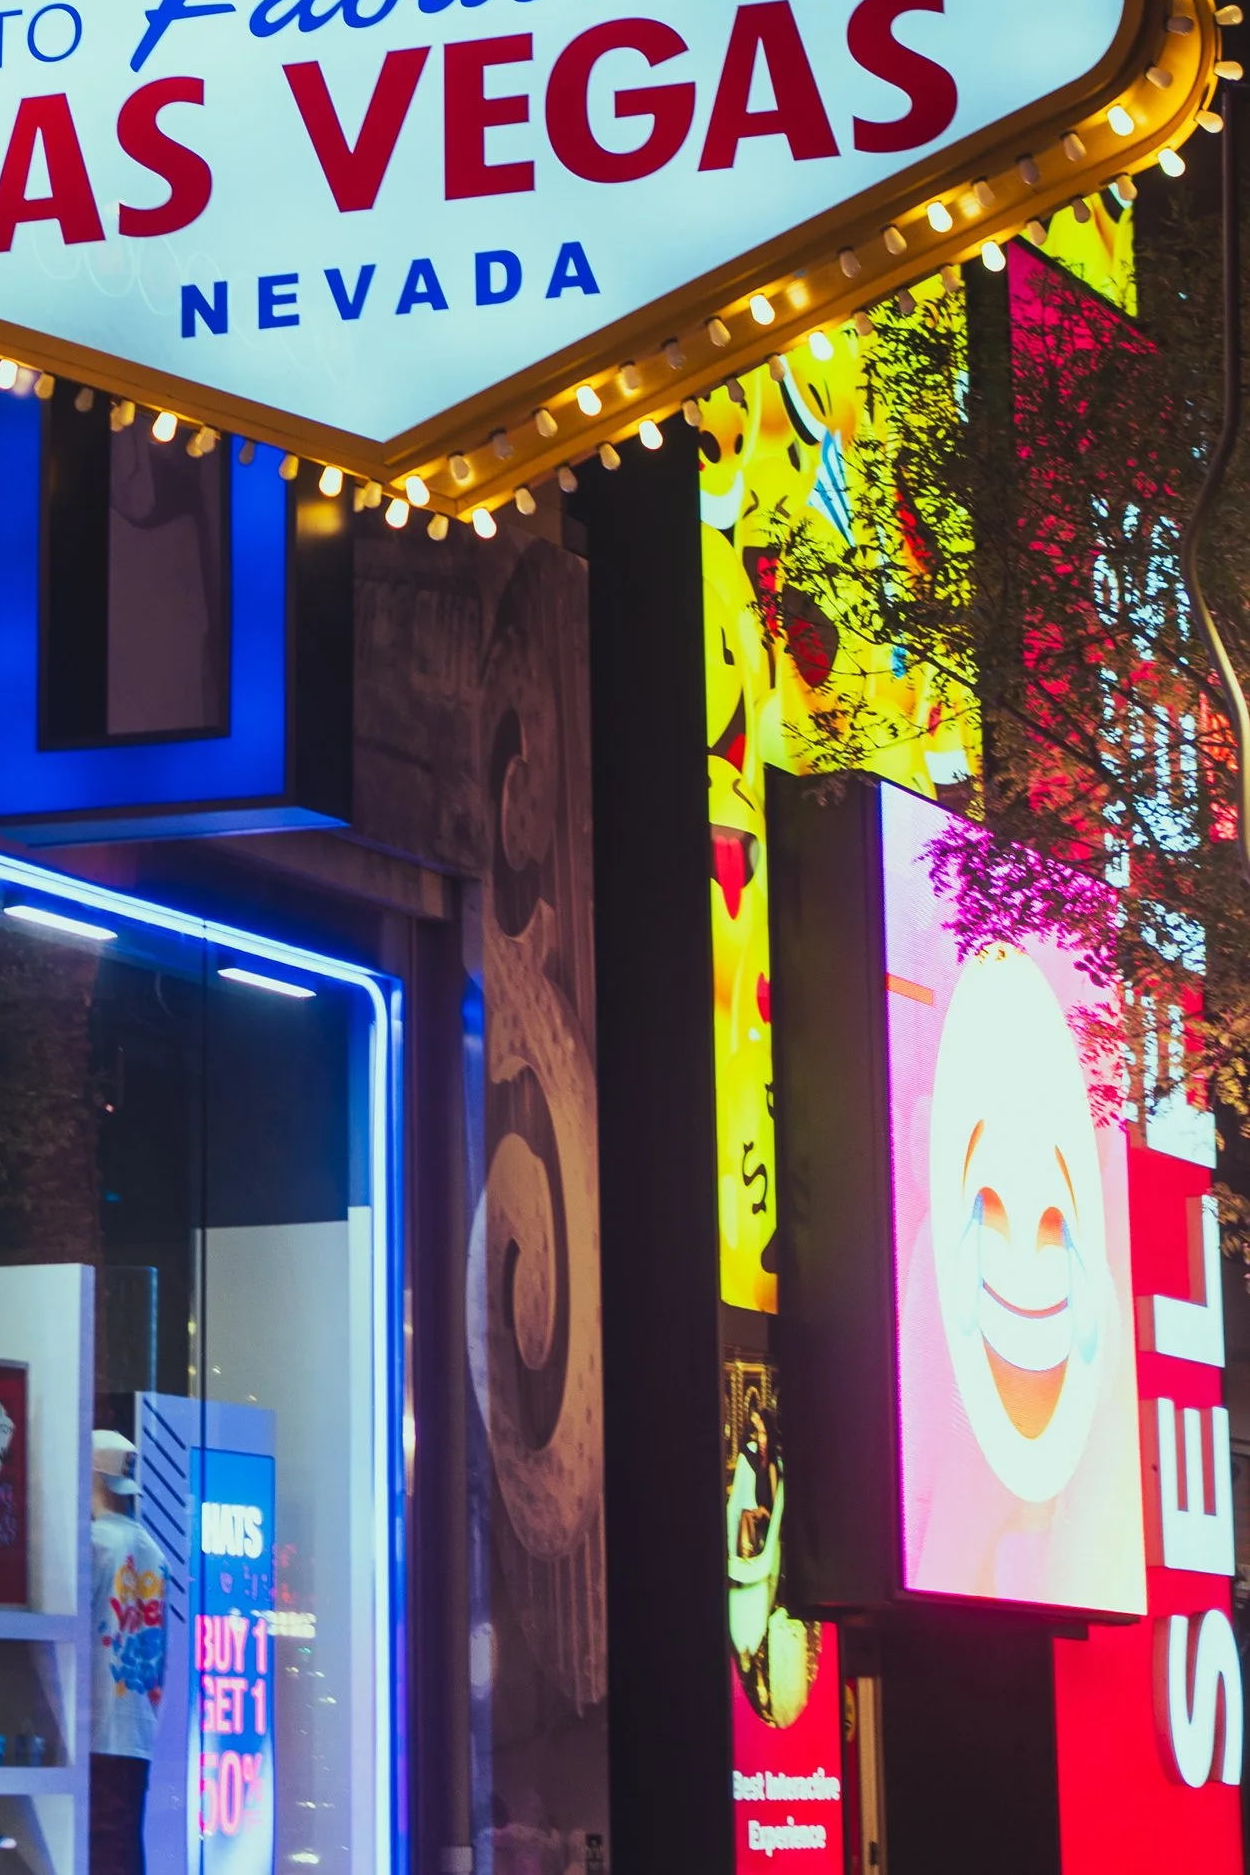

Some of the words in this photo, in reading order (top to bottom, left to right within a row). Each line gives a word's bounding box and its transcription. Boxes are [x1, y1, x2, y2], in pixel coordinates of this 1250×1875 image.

[180, 241, 601, 339] NEVADA
[202, 1502, 263, 1559] HATS
[194, 1614, 250, 1674] BUY
[252, 1618, 267, 1674] 1
[200, 1675, 248, 1735] GET
[251, 1678, 266, 1735] 1
